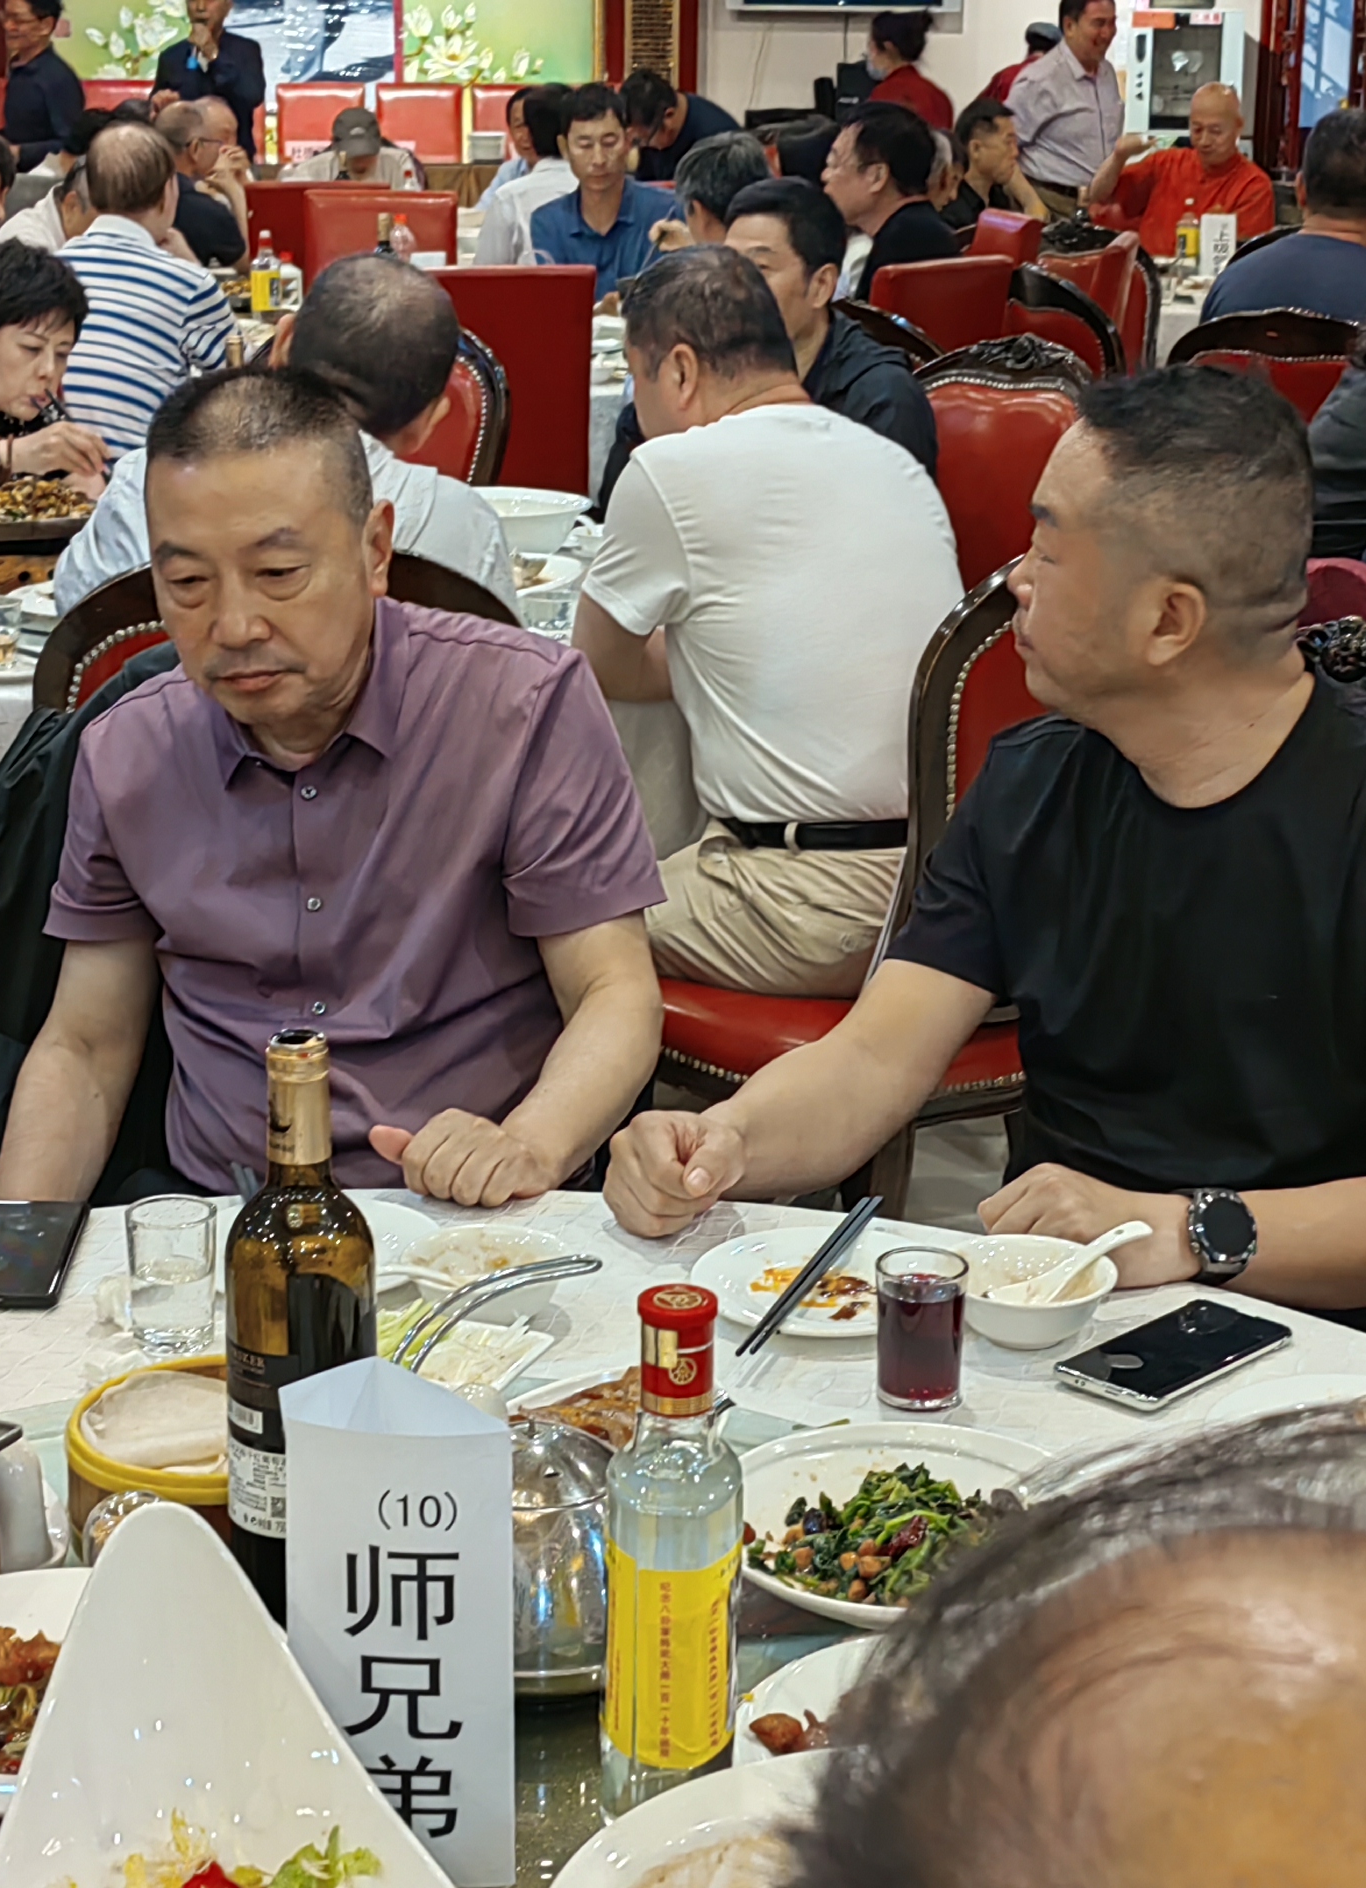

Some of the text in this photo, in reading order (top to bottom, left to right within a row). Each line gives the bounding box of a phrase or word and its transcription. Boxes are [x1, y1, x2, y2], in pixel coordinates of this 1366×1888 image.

[378, 1489, 457, 1531] (10)
[343, 1544, 463, 1838] 师兄弟
